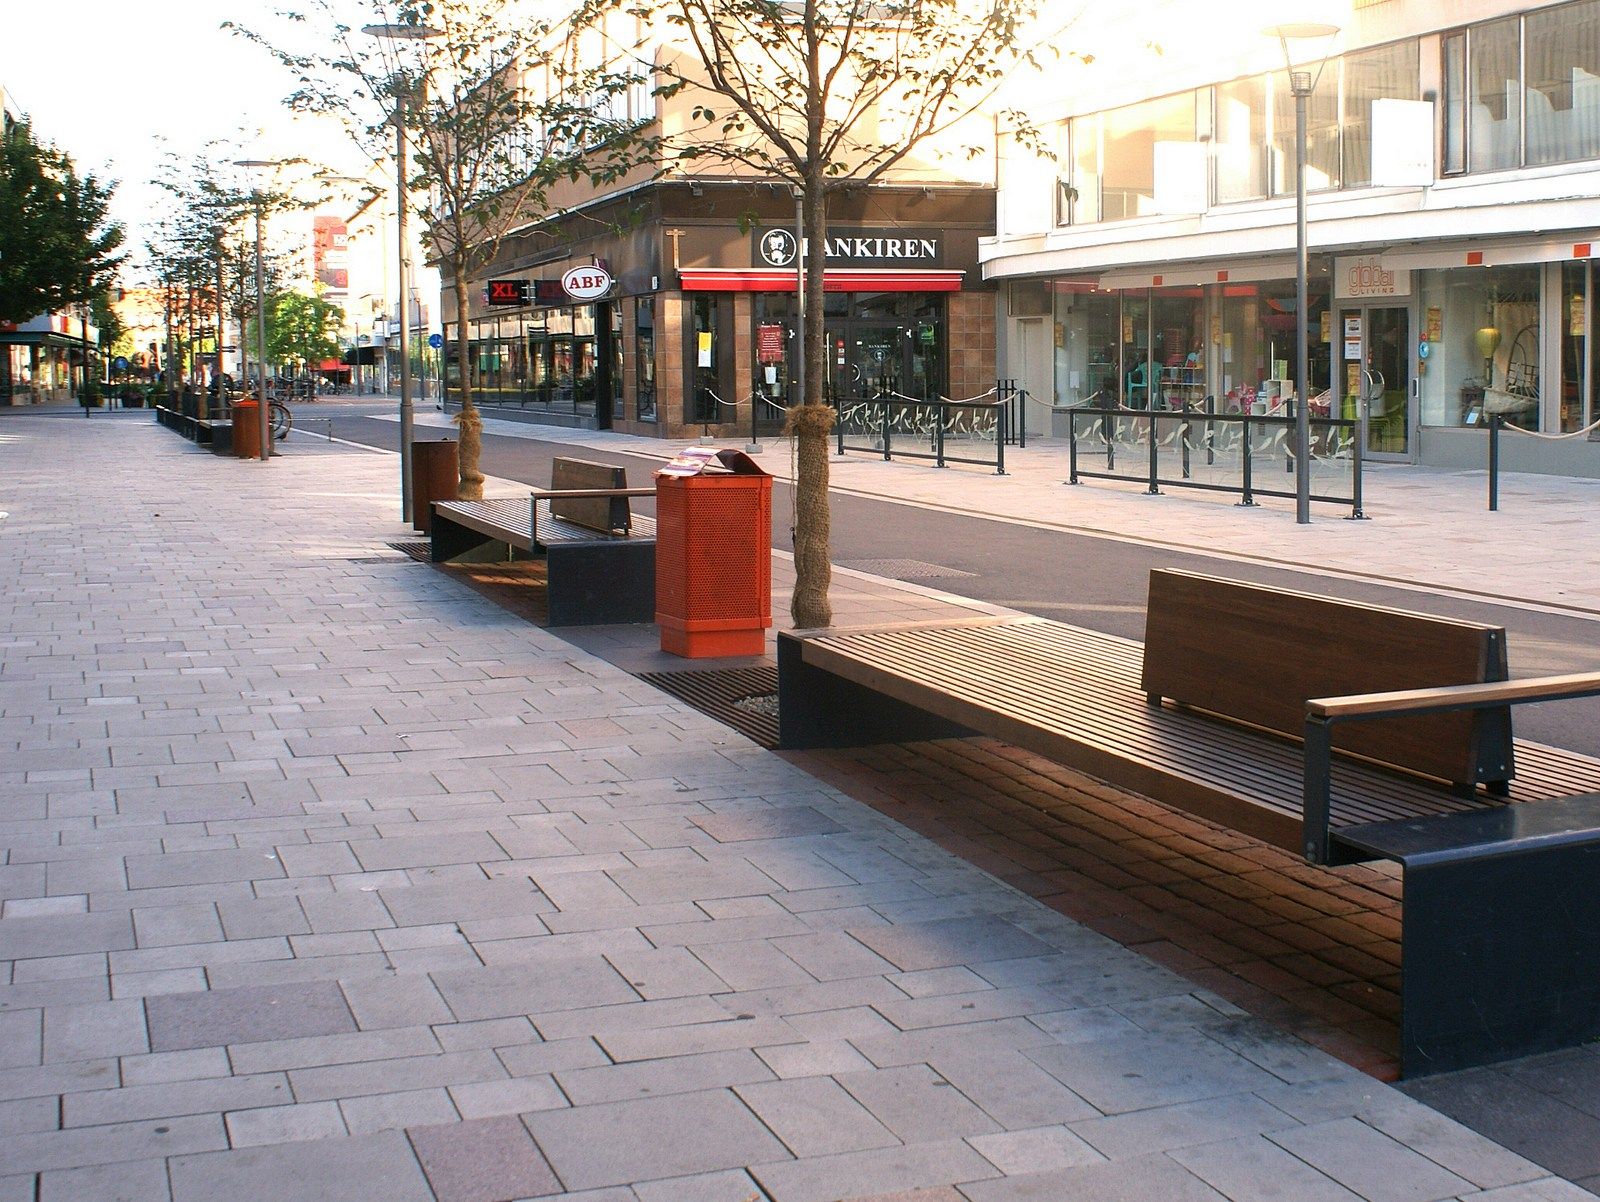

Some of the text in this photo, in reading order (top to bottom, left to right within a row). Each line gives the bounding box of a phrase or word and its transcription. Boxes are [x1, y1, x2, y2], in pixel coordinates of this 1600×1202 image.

[568, 275, 605, 289] ABF
[492, 282, 518, 297] XL
[1360, 287, 1395, 295] LIVING
